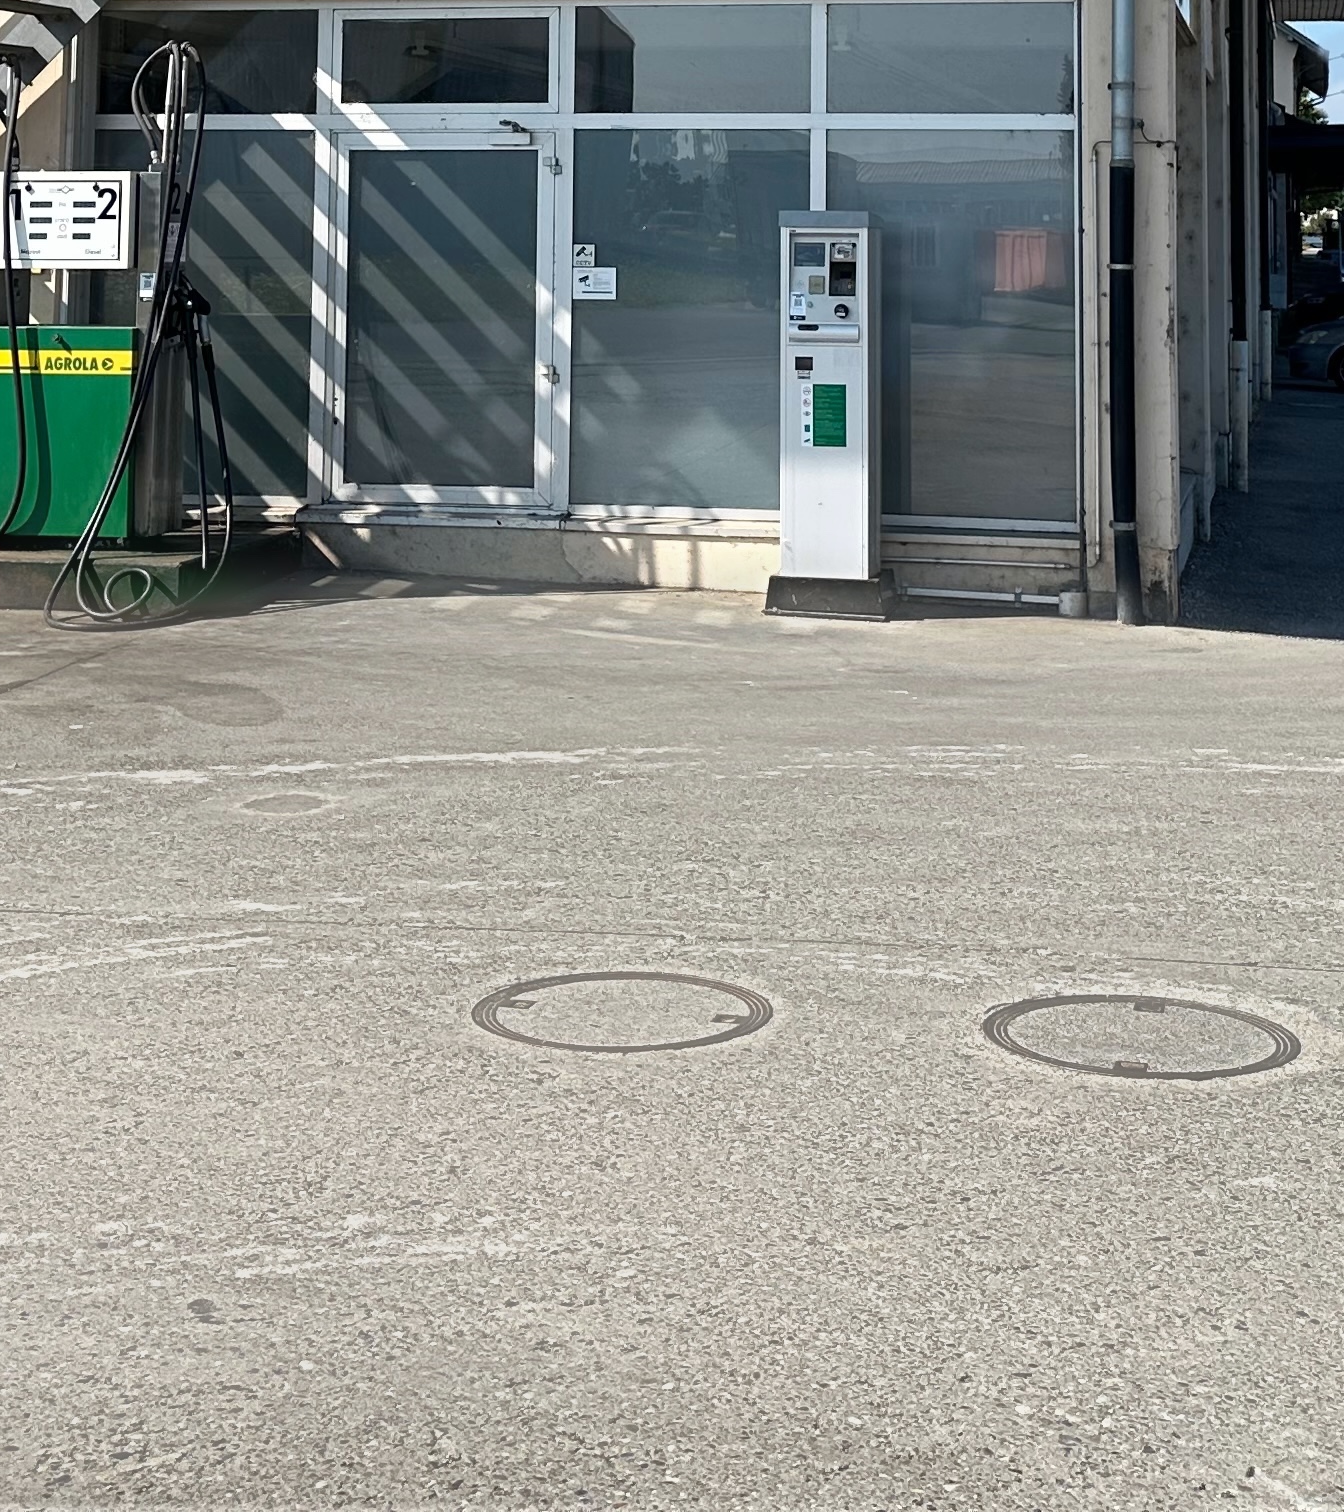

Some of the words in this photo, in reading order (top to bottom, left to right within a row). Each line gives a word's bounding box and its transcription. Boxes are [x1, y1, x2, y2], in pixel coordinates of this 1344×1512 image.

[10, 189, 22, 221] 1
[97, 187, 118, 220] 2
[44, 356, 99, 371] AGROLA
